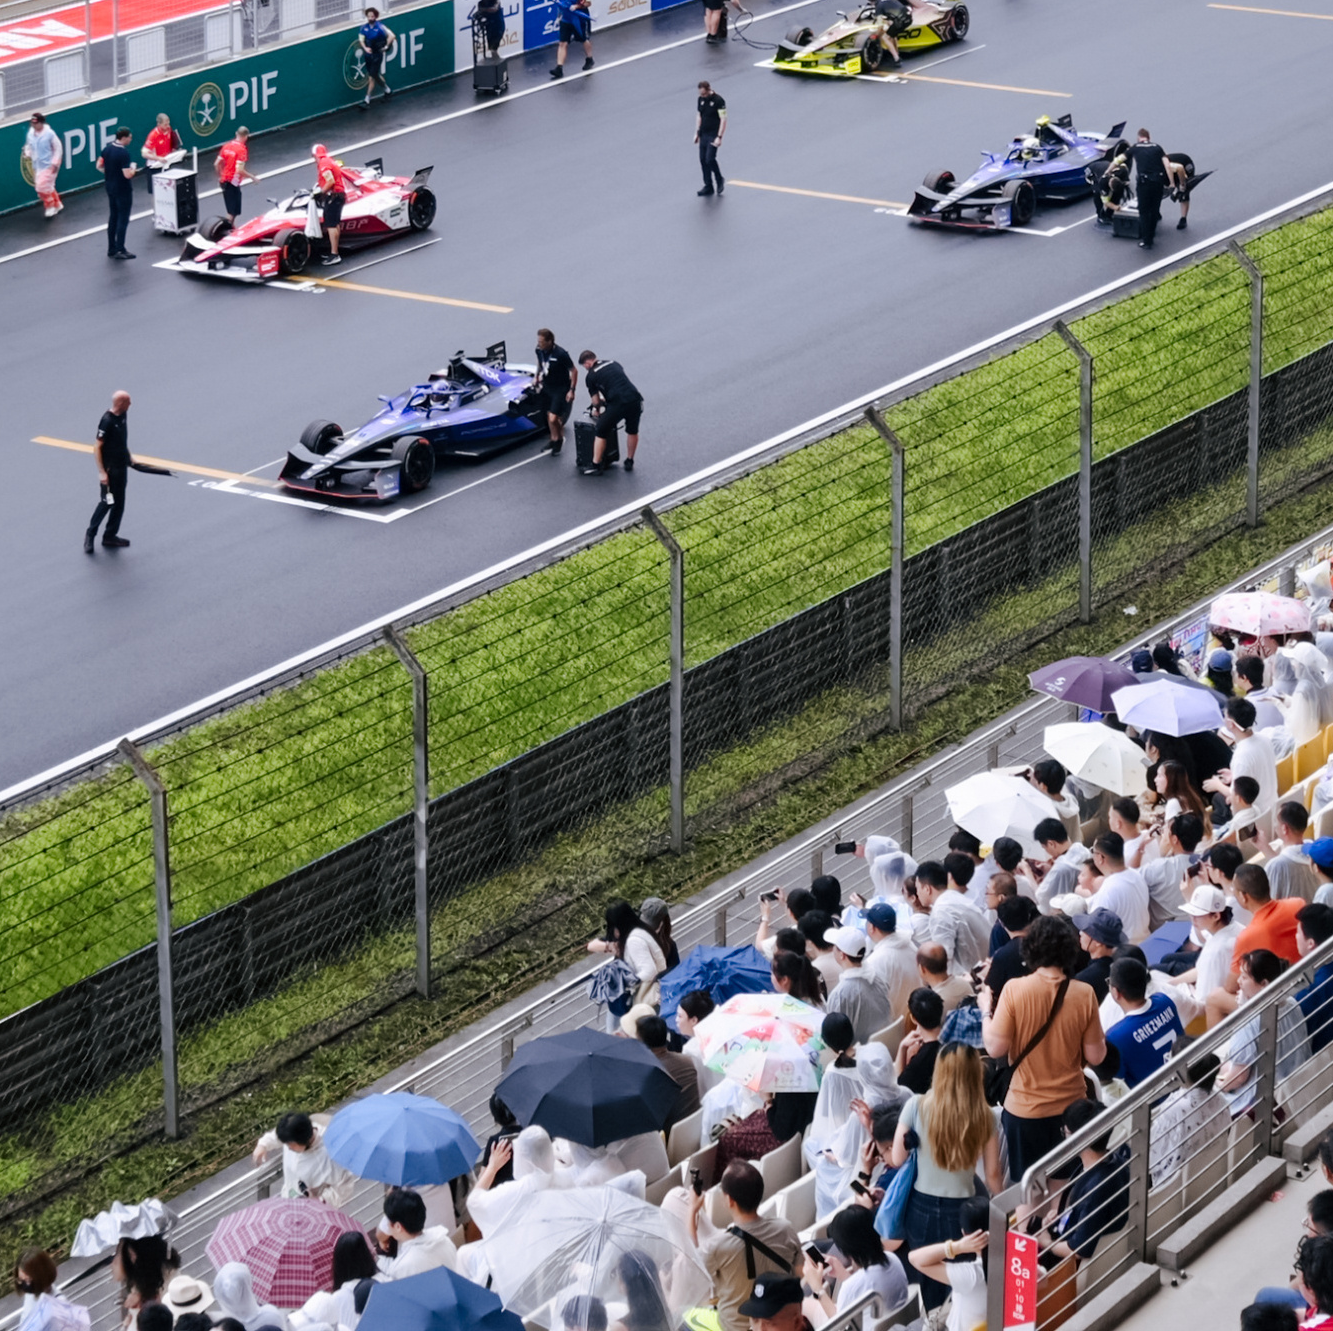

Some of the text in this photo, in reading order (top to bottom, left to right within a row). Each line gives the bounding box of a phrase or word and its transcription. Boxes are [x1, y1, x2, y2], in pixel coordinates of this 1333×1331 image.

[229, 70, 279, 120] PIF
[1132, 1006, 1175, 1043] GRIEZMANN
[1011, 1257, 1030, 1279] 8a
[1015, 1278, 1025, 1288] 01
[1015, 1294, 1024, 1303] 10
